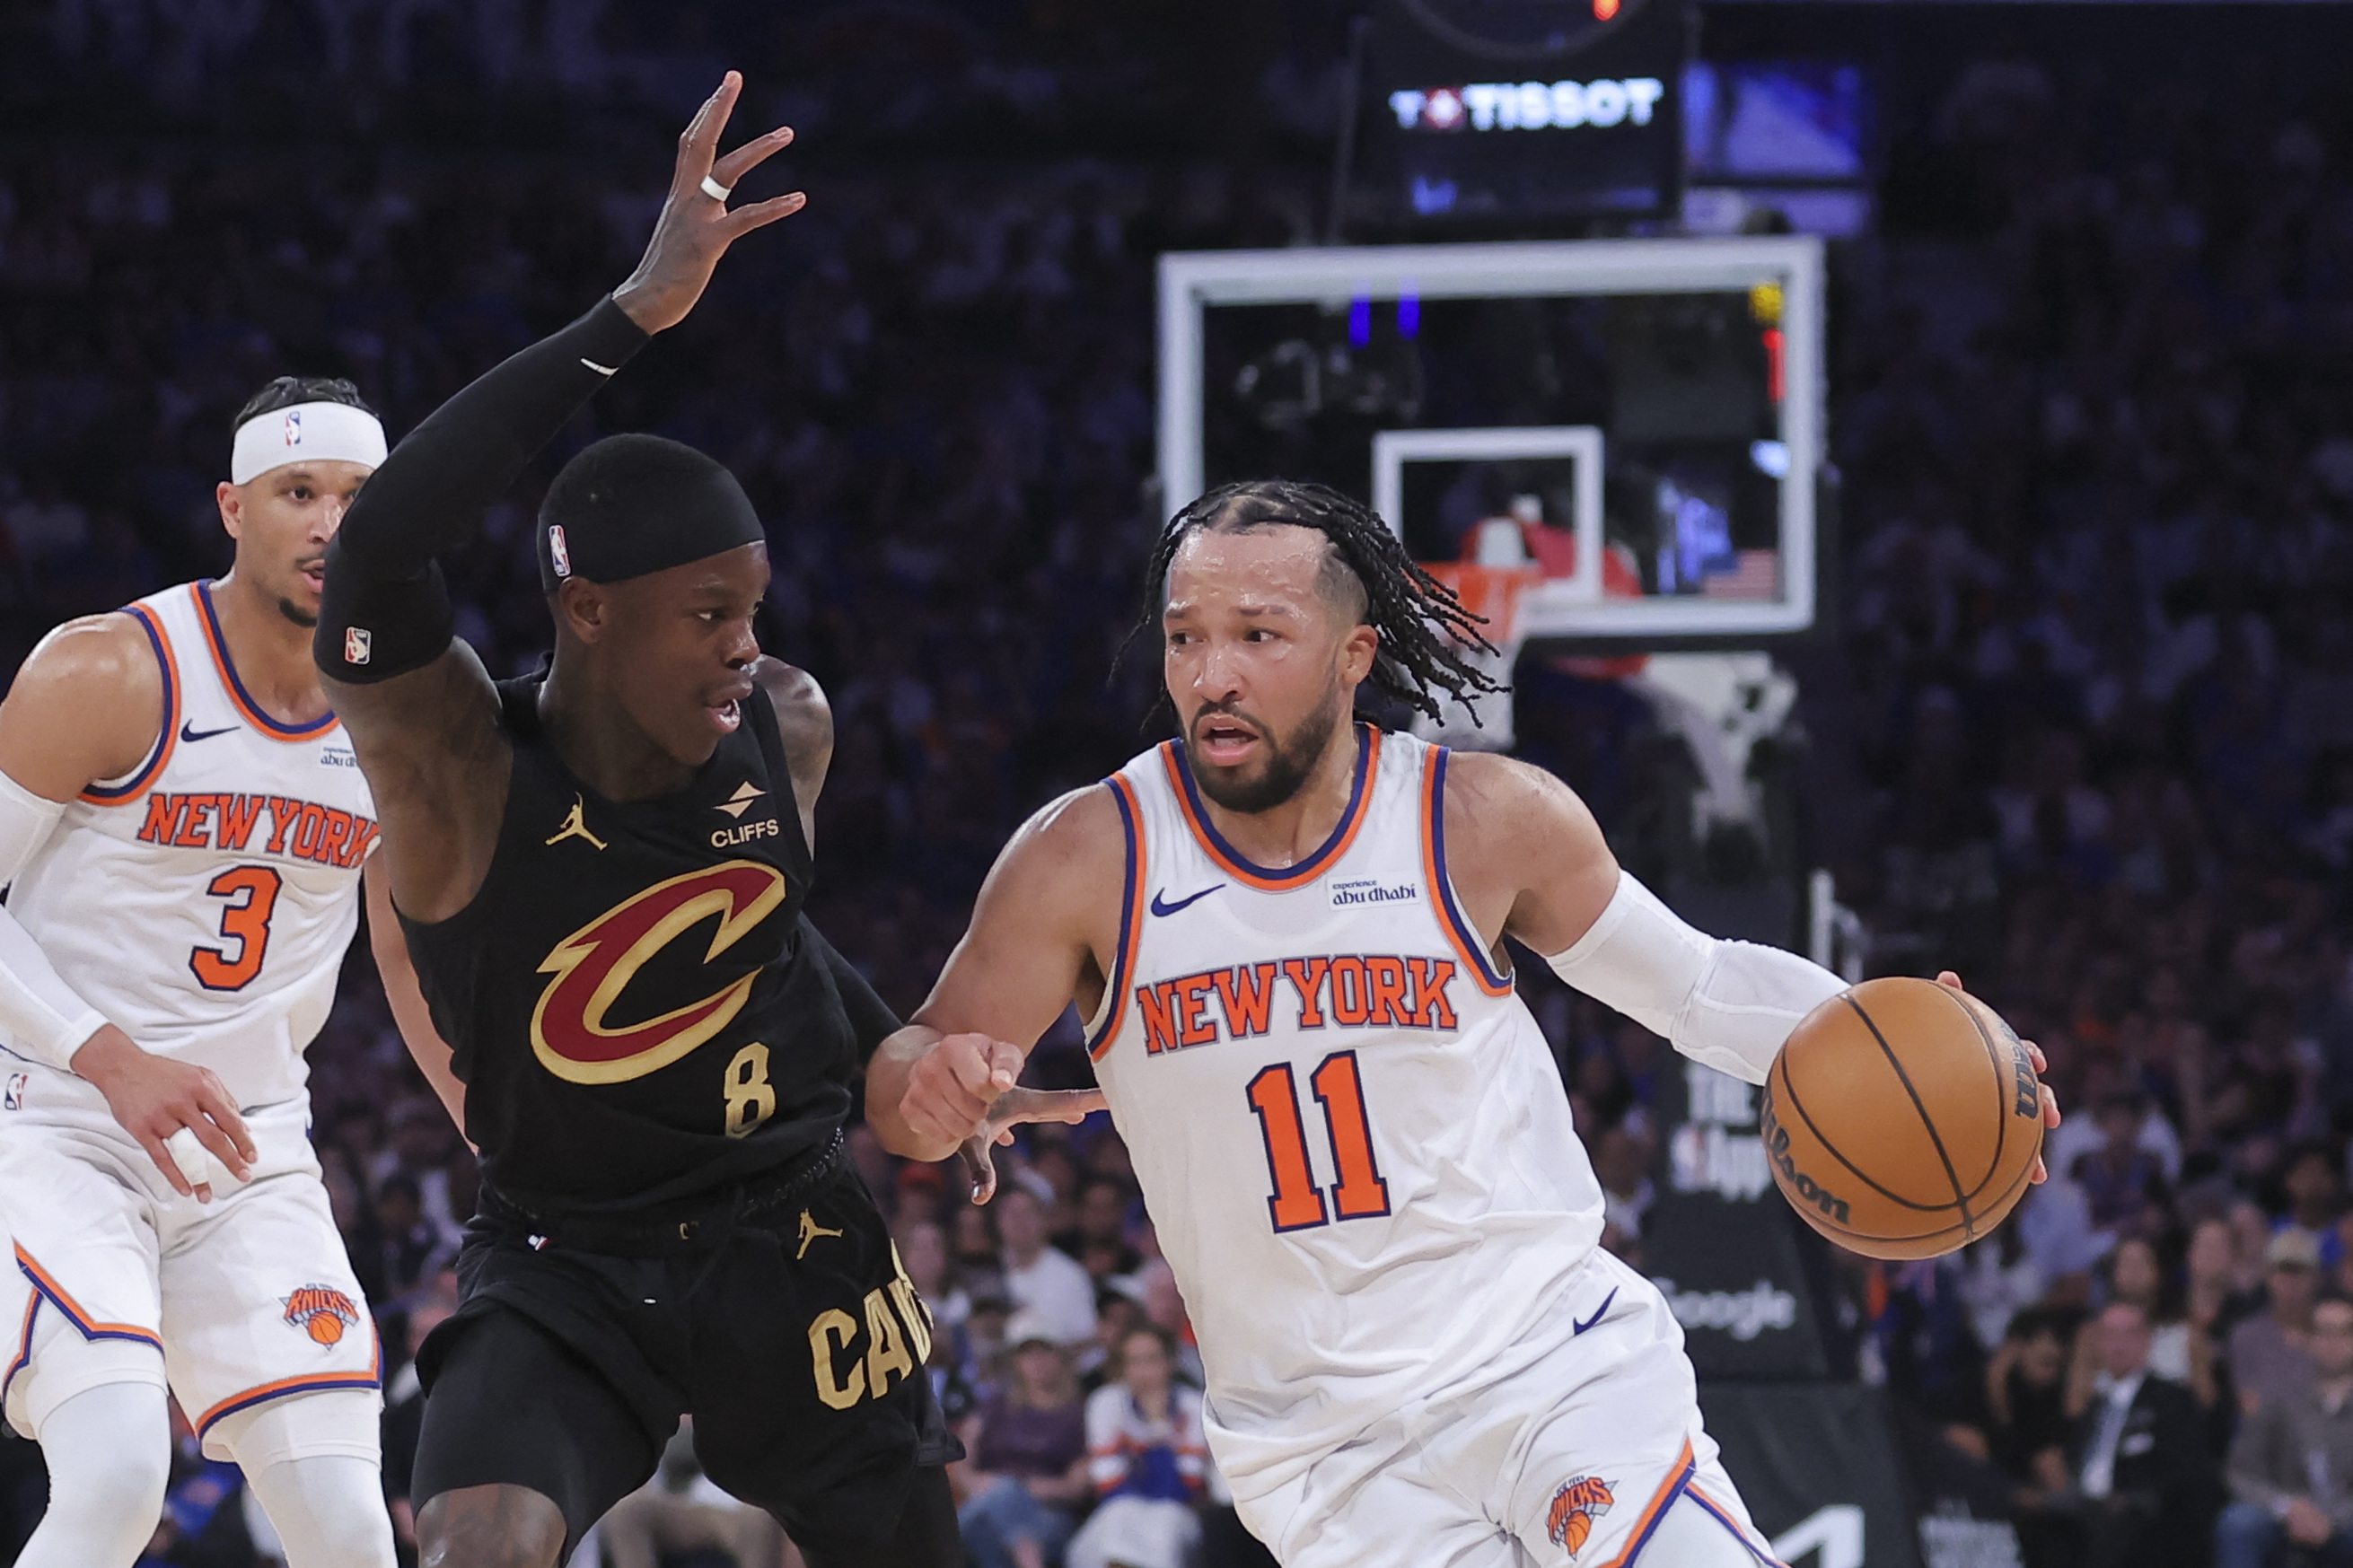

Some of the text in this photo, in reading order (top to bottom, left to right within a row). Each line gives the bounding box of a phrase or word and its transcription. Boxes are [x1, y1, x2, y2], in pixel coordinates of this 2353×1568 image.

[1462, 77, 1664, 132] TISSOT
[136, 792, 381, 869] NEW YORK
[710, 819, 779, 848] CLIFFS
[1332, 880, 1377, 890] experience
[1332, 883, 1417, 906] abu dhabi
[189, 864, 283, 991] 3
[530, 859, 786, 1085] C
[1135, 953, 1459, 1057] NEW YORK
[723, 1041, 777, 1139] 8
[1245, 1049, 1392, 1234] 11
[284, 1287, 360, 1321] KNICKS
